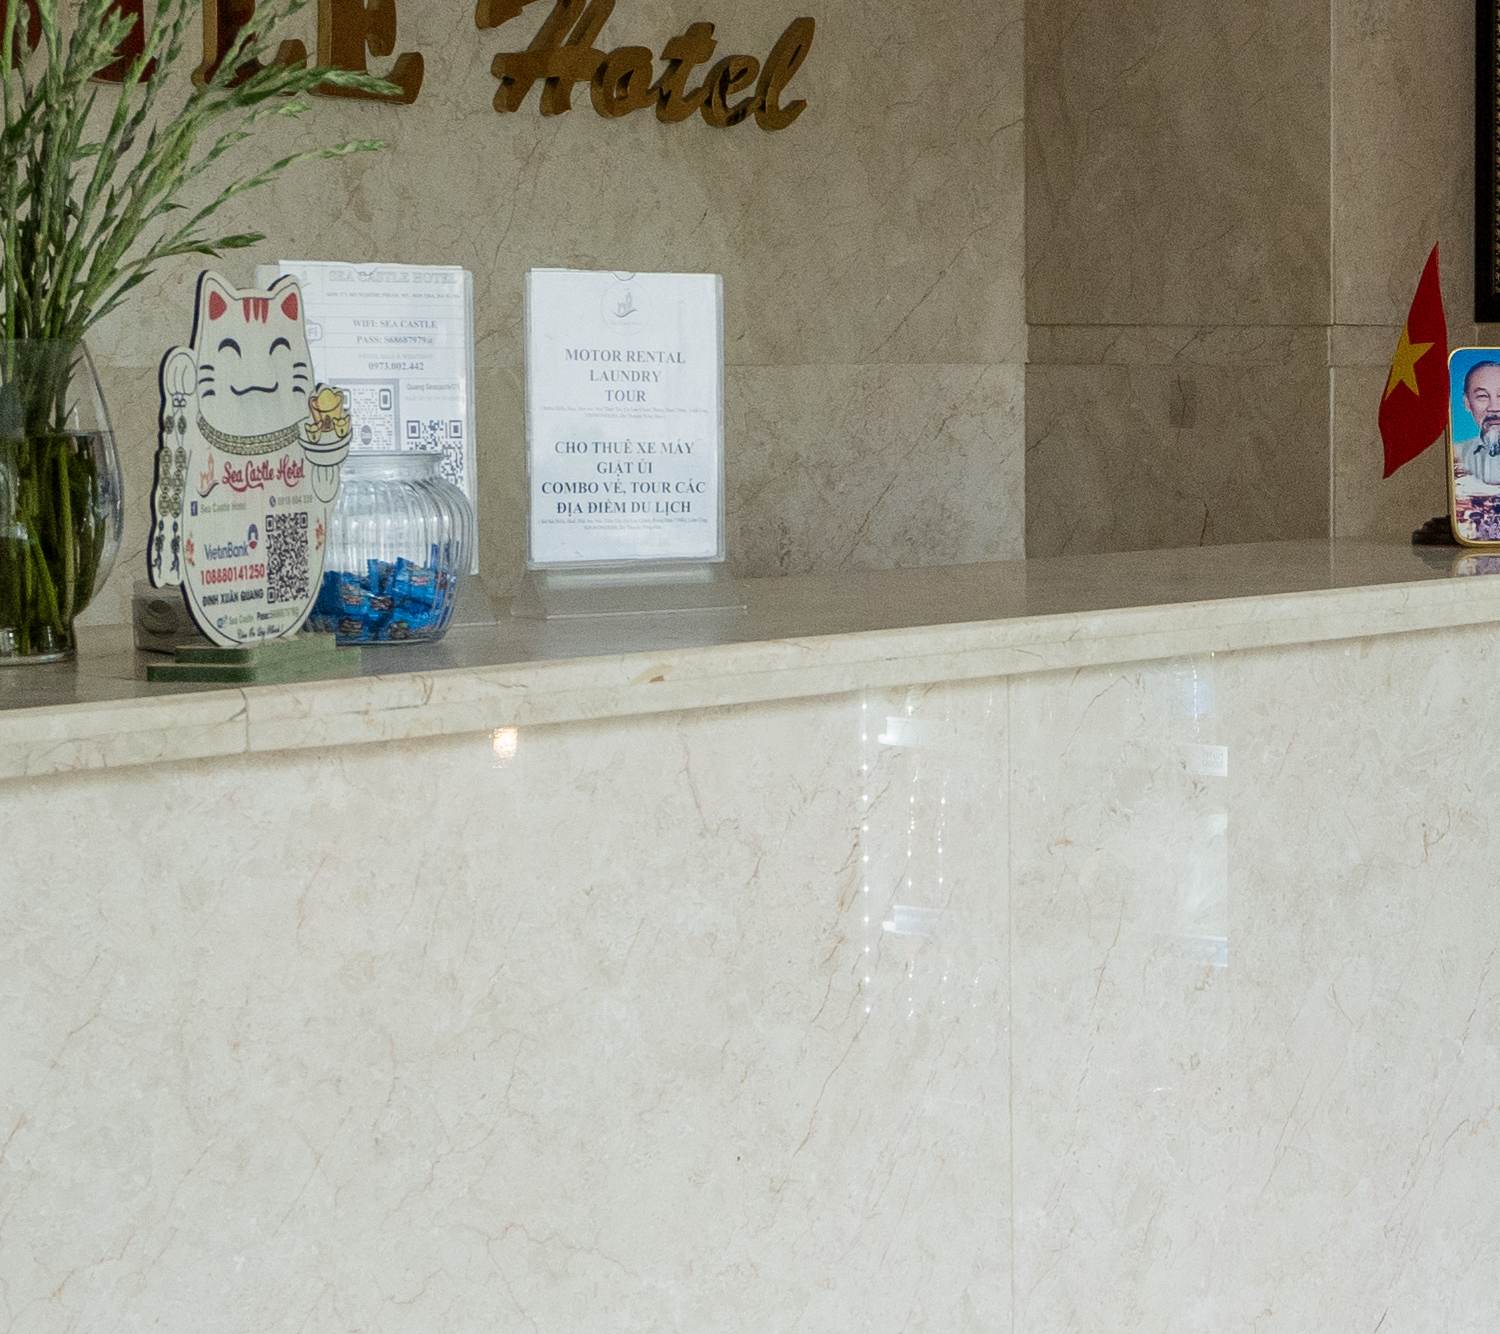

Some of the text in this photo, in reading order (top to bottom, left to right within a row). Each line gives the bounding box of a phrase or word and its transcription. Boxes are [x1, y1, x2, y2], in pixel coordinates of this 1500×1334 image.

[353, 319, 437, 329] WIFI: SEA CASTLE
[356, 336, 382, 344] PASS:
[564, 348, 686, 364] MOTOR RENTAL
[368, 361, 424, 371] 0973.002.442
[589, 369, 662, 383] LAUNDRY
[605, 389, 647, 402] TOUR
[554, 438, 695, 455] CHO THUÊ XE MÁY
[221, 454, 306, 493] Sea Castle Hotel
[541, 481, 599, 495] COMBO
[630, 481, 672, 494] TOUR
[675, 478, 706, 494] CÁC
[557, 498, 691, 517] ĐỊA ĐIỂM DU LỊCH
[204, 541, 249, 561] VietinBank
[200, 563, 266, 585] 108880141250
[220, 589, 239, 603] XUÂN
[240, 588, 264, 602] QUANG
